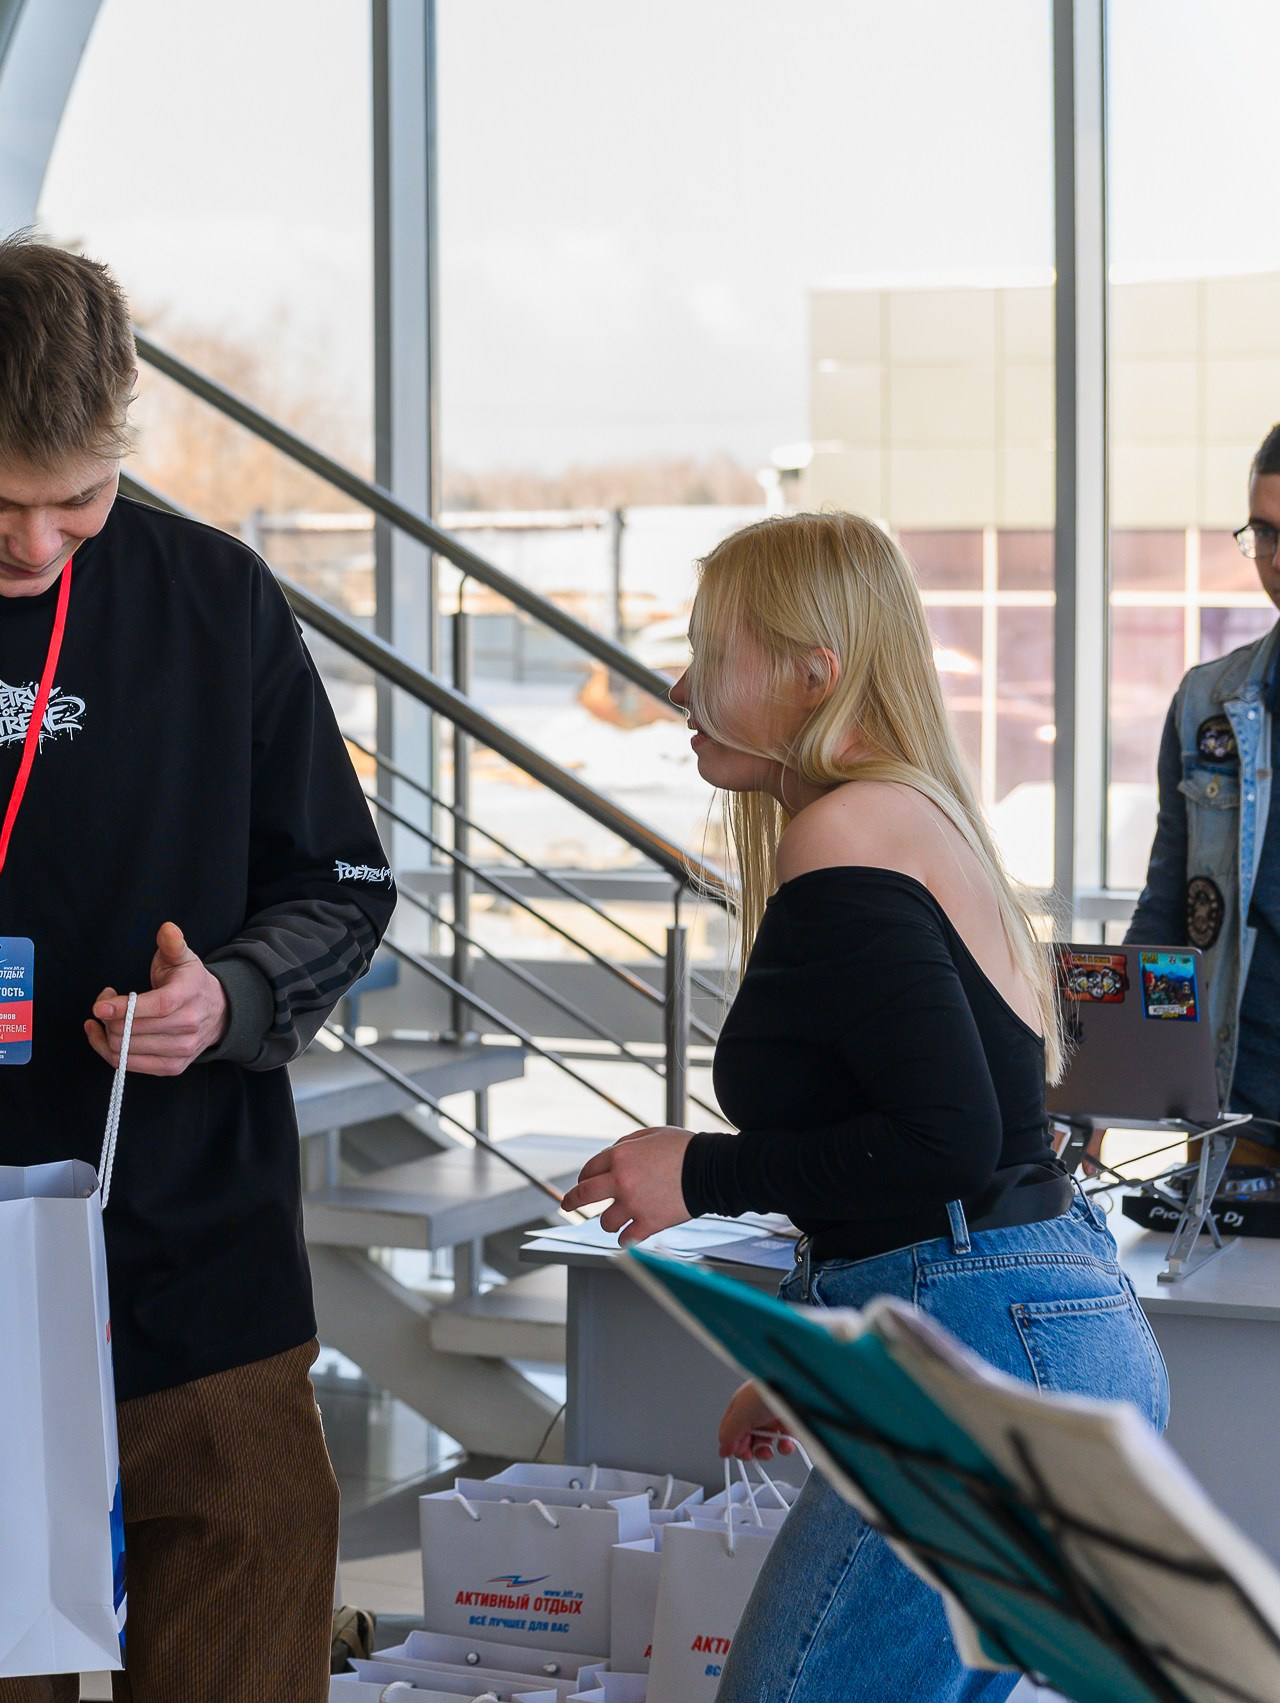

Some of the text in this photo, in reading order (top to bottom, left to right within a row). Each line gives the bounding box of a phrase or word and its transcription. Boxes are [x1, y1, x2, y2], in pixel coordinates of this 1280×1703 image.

[455, 1590, 583, 1615] АКТИВНЫЙ ОТДЫХ
[488, 1616, 527, 1630] ЛУЧШЕЕ
[528, 1620, 549, 1632] ДЛЯ
[550, 1622, 569, 1633] ВАС
